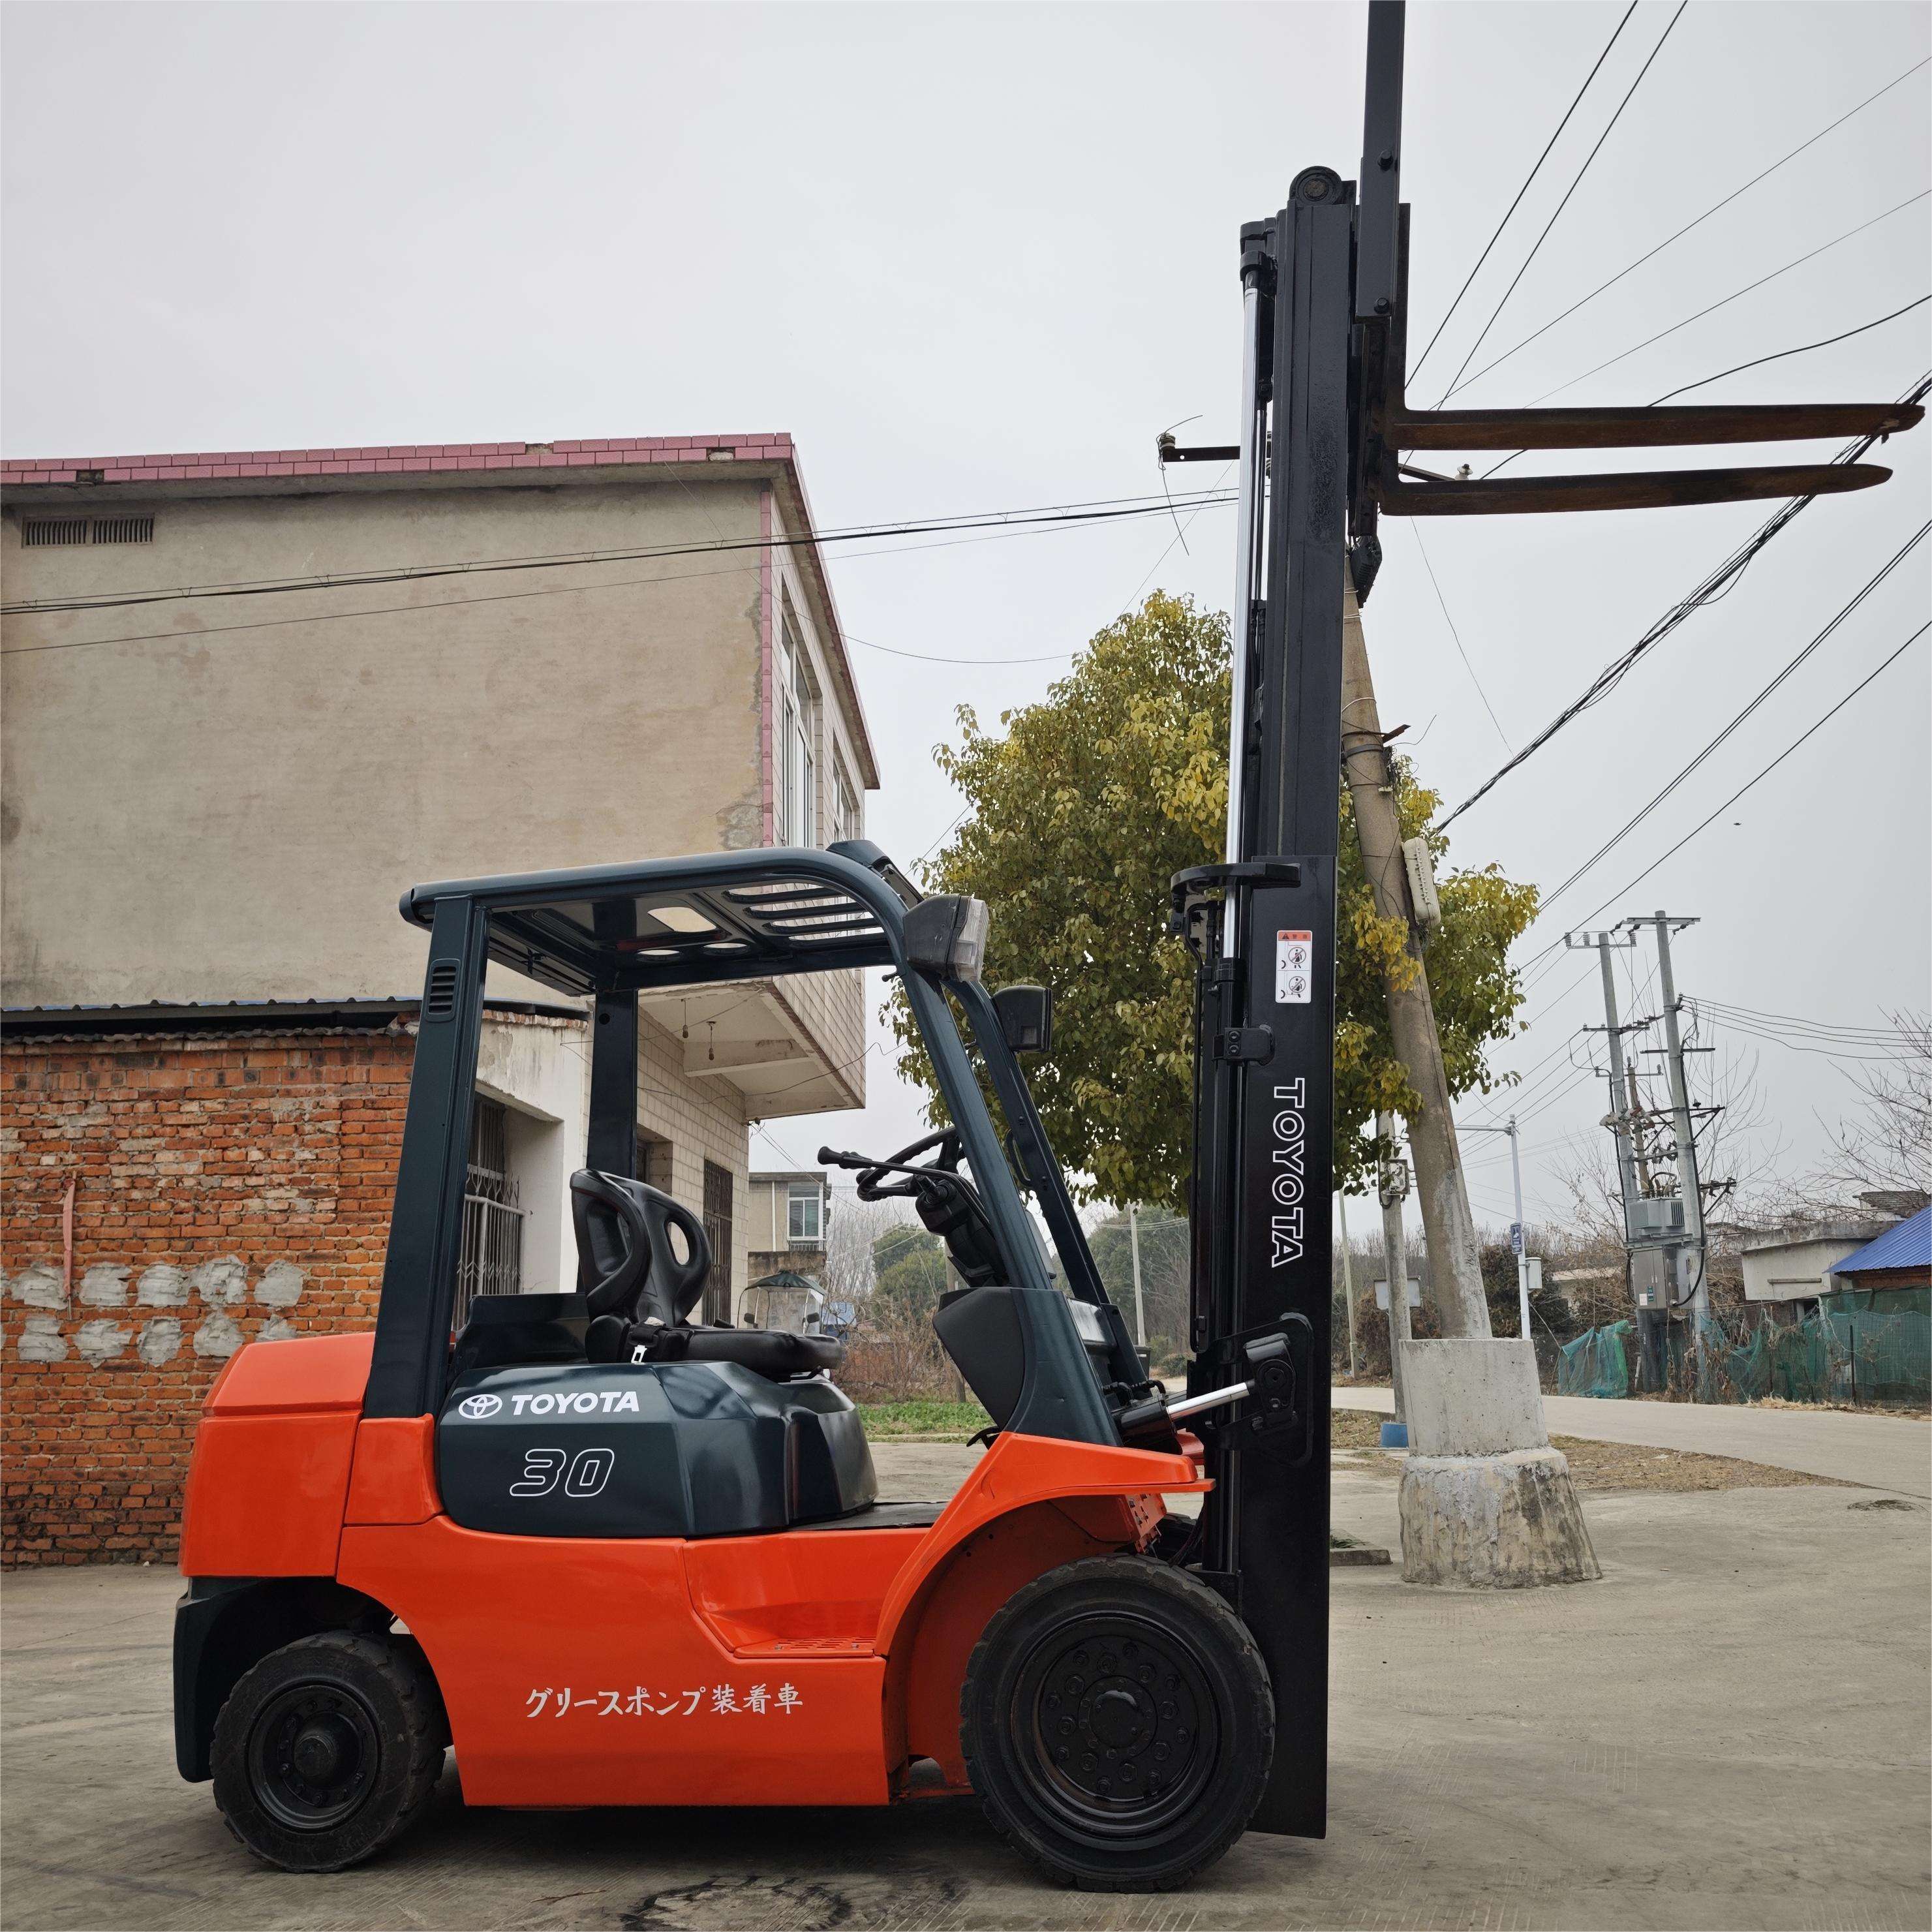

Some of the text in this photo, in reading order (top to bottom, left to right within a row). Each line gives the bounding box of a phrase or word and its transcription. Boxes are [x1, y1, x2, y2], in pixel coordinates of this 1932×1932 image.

[1272, 1078, 1305, 1268] TOYOTA
[512, 1391, 639, 1415] TOYOTA
[509, 1448, 615, 1497] 30
[526, 1683, 803, 1717] グリースポンプ装着車
